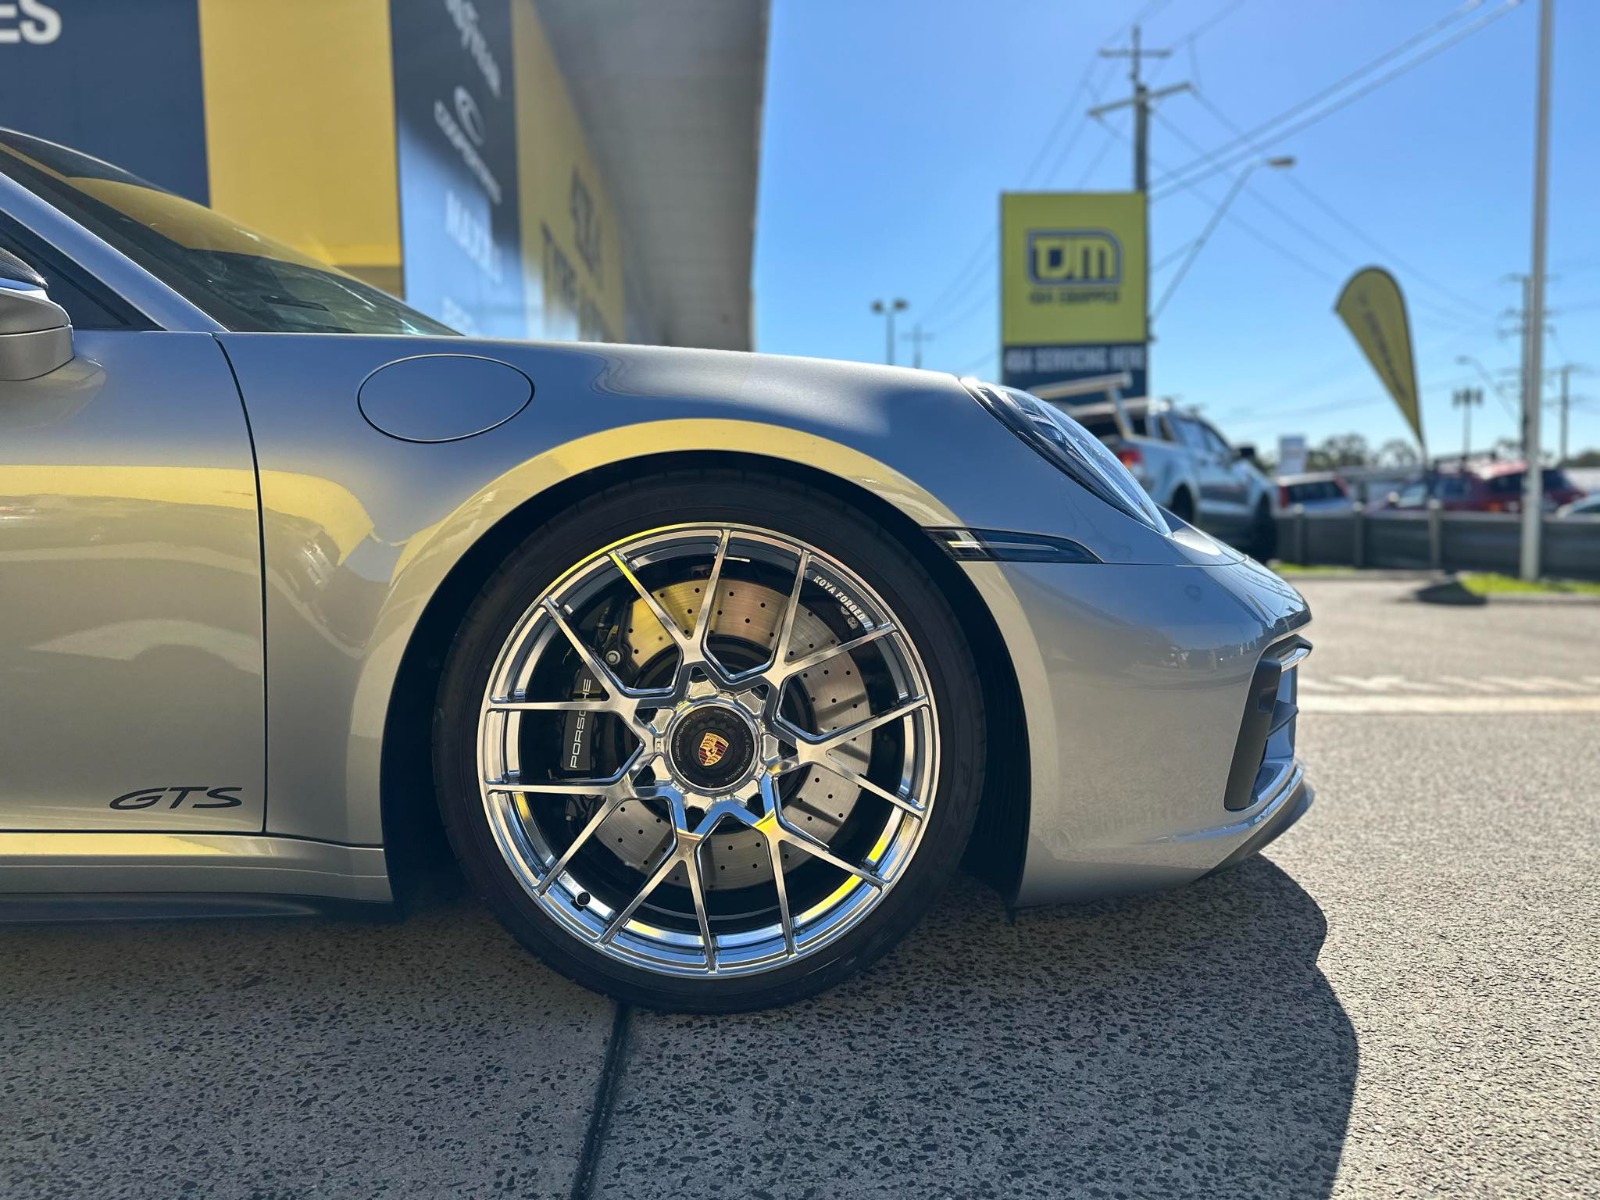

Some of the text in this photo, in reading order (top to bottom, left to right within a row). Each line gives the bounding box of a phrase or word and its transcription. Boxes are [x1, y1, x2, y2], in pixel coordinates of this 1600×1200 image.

[813, 576, 865, 620] KOYA FORGED
[109, 786, 243, 811] GTS
